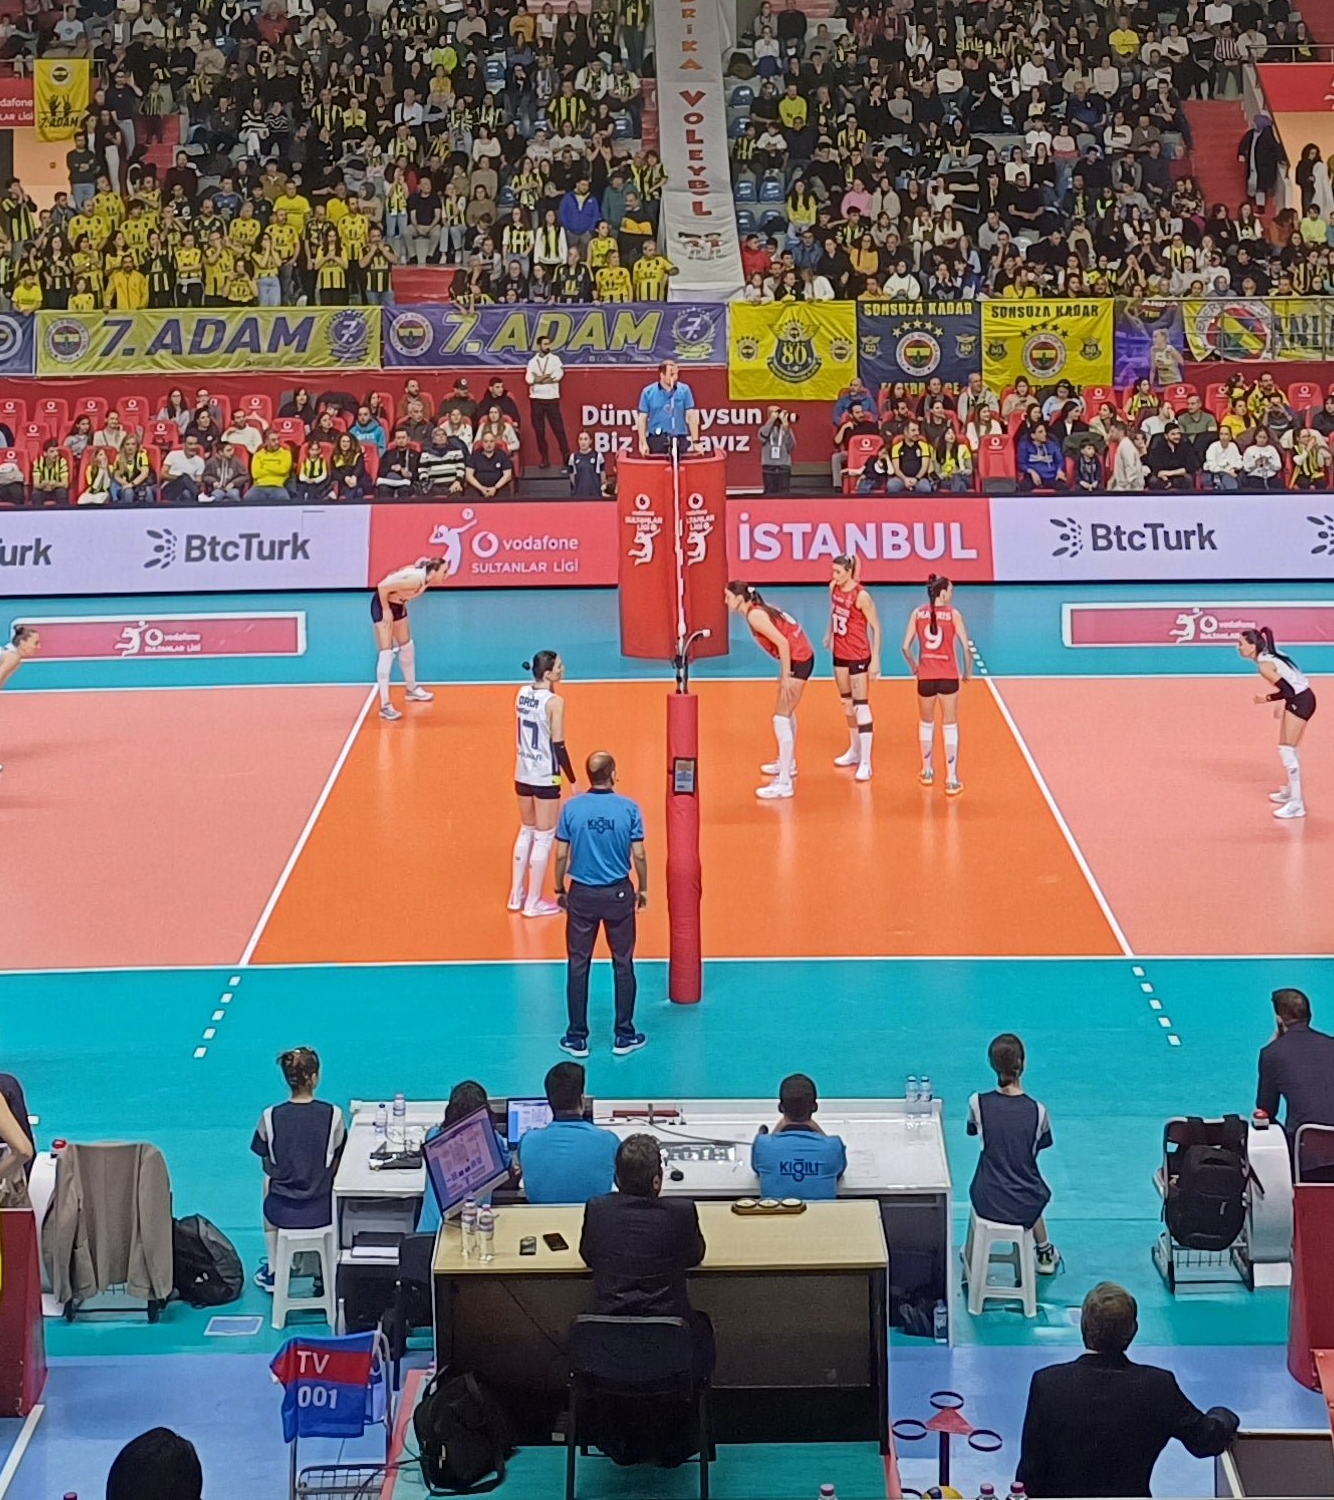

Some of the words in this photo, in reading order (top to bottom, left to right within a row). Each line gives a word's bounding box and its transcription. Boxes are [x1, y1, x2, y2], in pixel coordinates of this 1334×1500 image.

[582, 404, 640, 431] Düny
[697, 408, 762, 430] ysun
[595, 432, 633, 453] Biz
[184, 531, 310, 564] BtcTurk
[503, 534, 579, 551] vodafone
[738, 512, 978, 561] İSTANBUL
[1090, 521, 1217, 553] BtcTurk
[471, 561, 547, 574] SULTANLAR
[554, 558, 579, 573] LİGİ
[924, 623, 943, 650] 9
[296, 1350, 330, 1374] TV
[297, 1385, 338, 1409] 001
